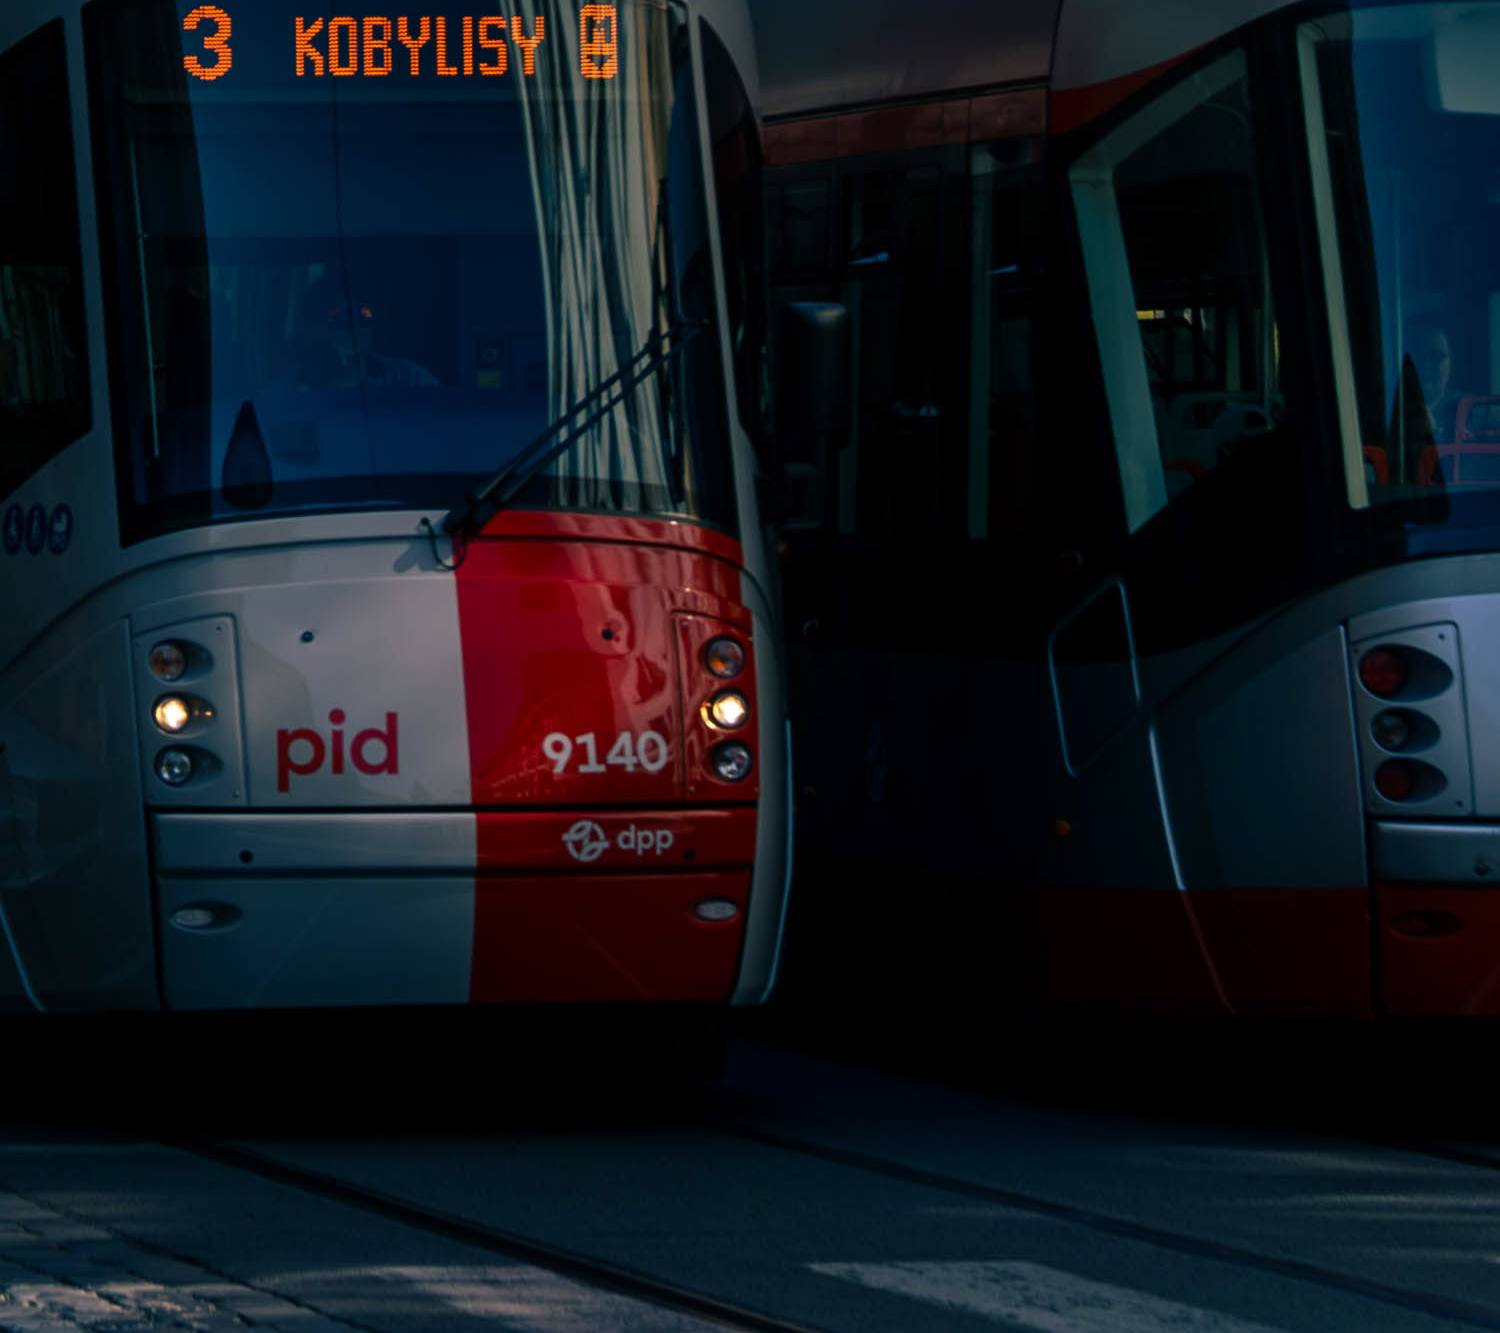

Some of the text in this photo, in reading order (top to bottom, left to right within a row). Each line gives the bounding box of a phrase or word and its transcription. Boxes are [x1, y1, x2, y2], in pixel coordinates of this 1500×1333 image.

[182, 4, 545, 82] 3 KOBYLISY
[276, 709, 400, 793] pid
[541, 729, 669, 775] 9140
[615, 823, 675, 854] dpp
